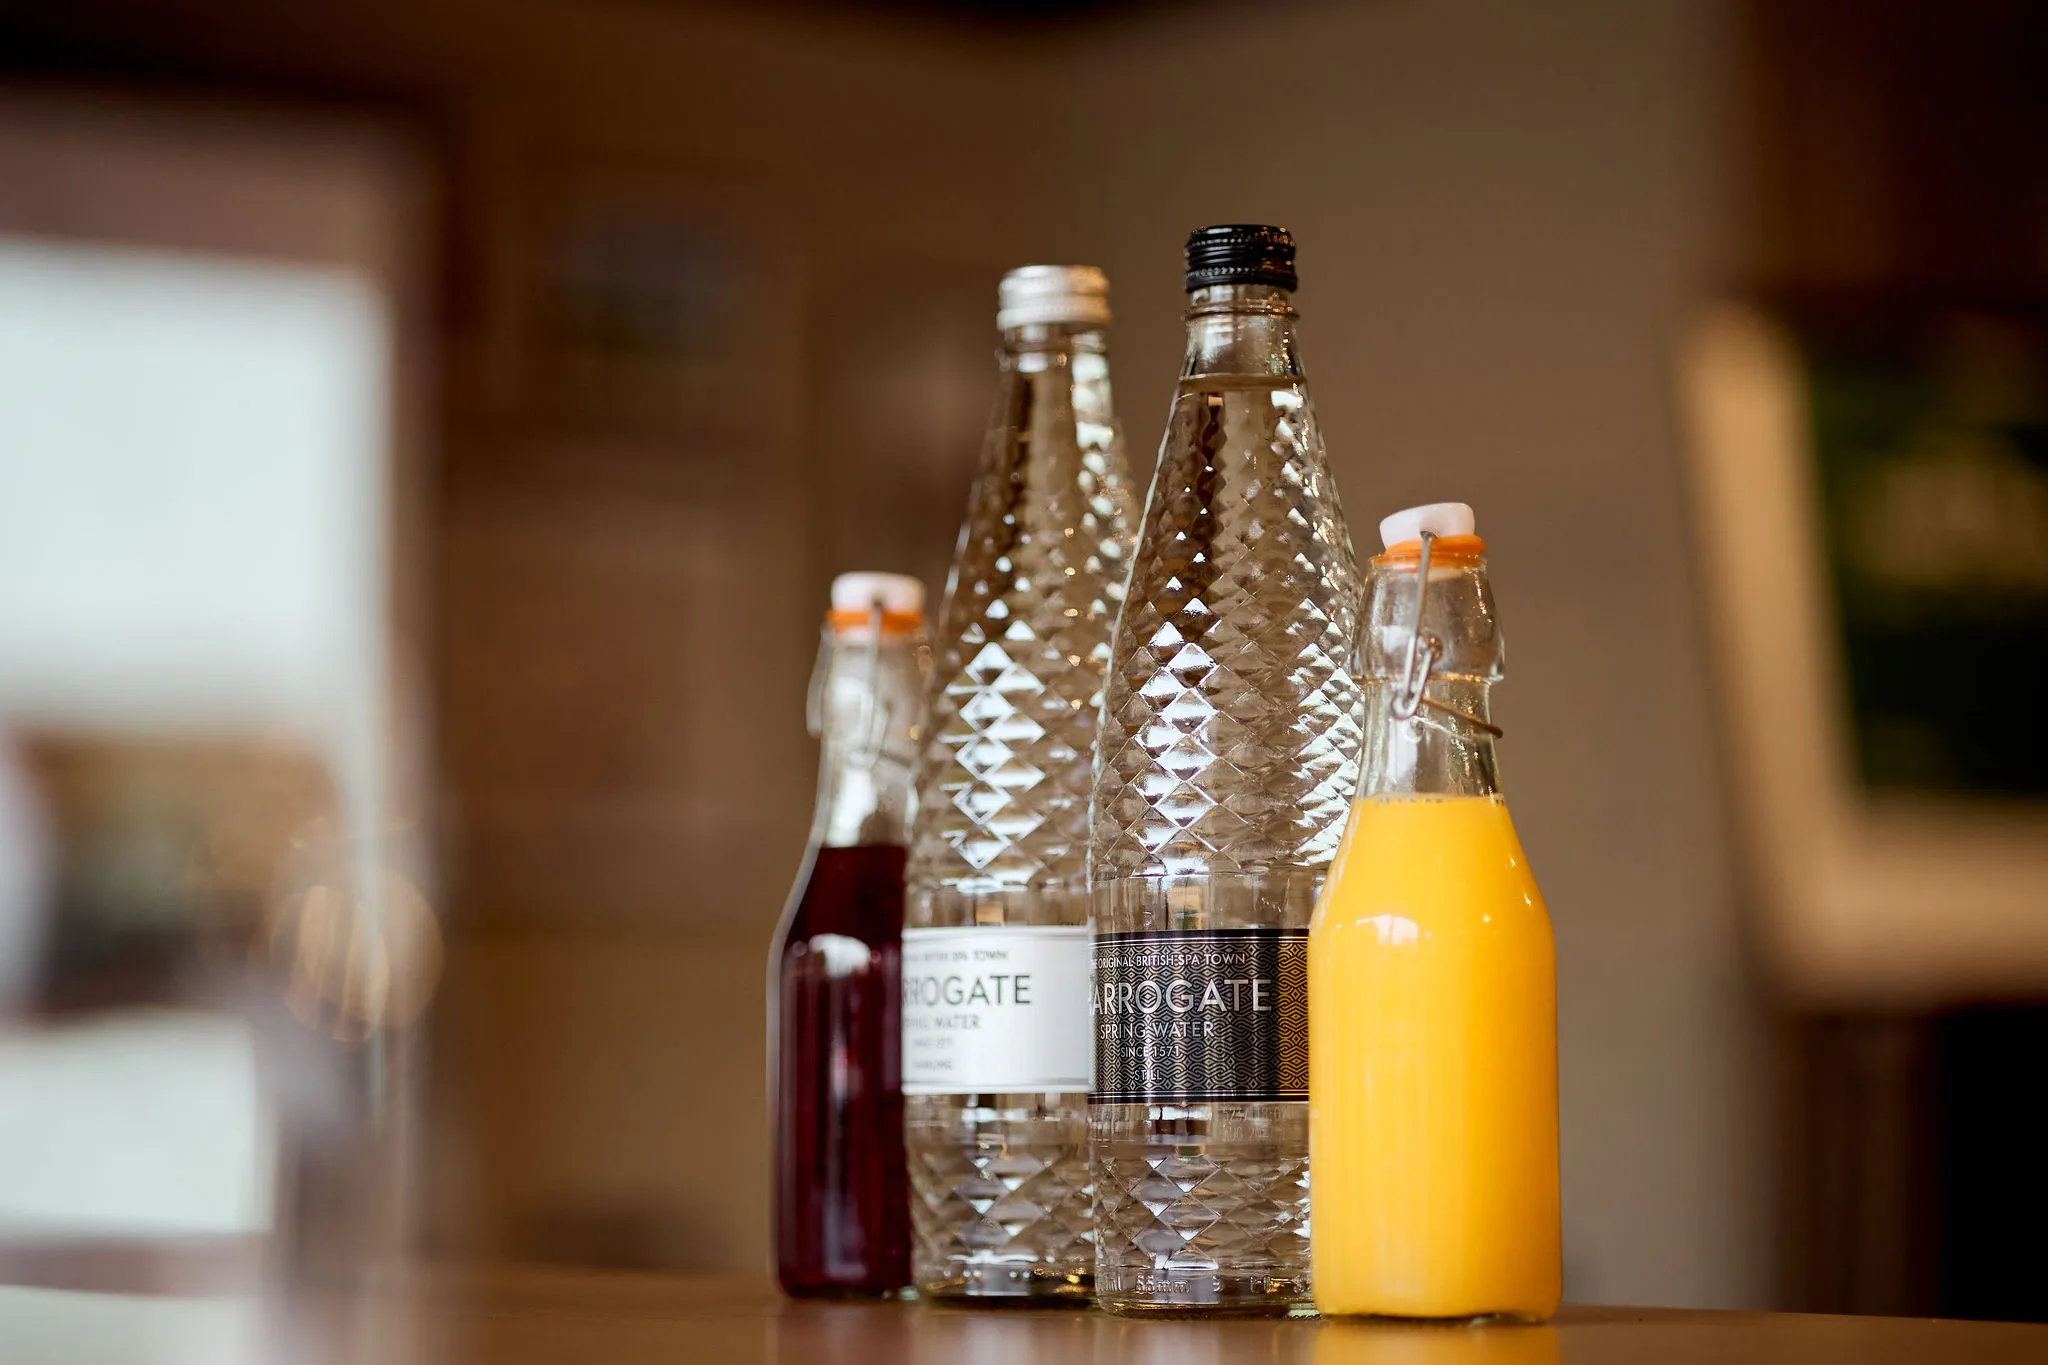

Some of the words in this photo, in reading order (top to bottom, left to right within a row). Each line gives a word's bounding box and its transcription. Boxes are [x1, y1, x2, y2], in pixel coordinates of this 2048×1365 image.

[1098, 956, 1133, 969] ORIGINAL
[1136, 954, 1175, 967] BRITISH
[1178, 953, 1200, 966] SPA
[1204, 953, 1246, 965] TOWN
[1100, 1023, 1147, 1039] SPRING
[1152, 1021, 1215, 1038] WATER
[1120, 1046, 1150, 1058] SINCE
[1153, 1045, 1180, 1057] 1571
[1134, 1069, 1162, 1080] STILL
